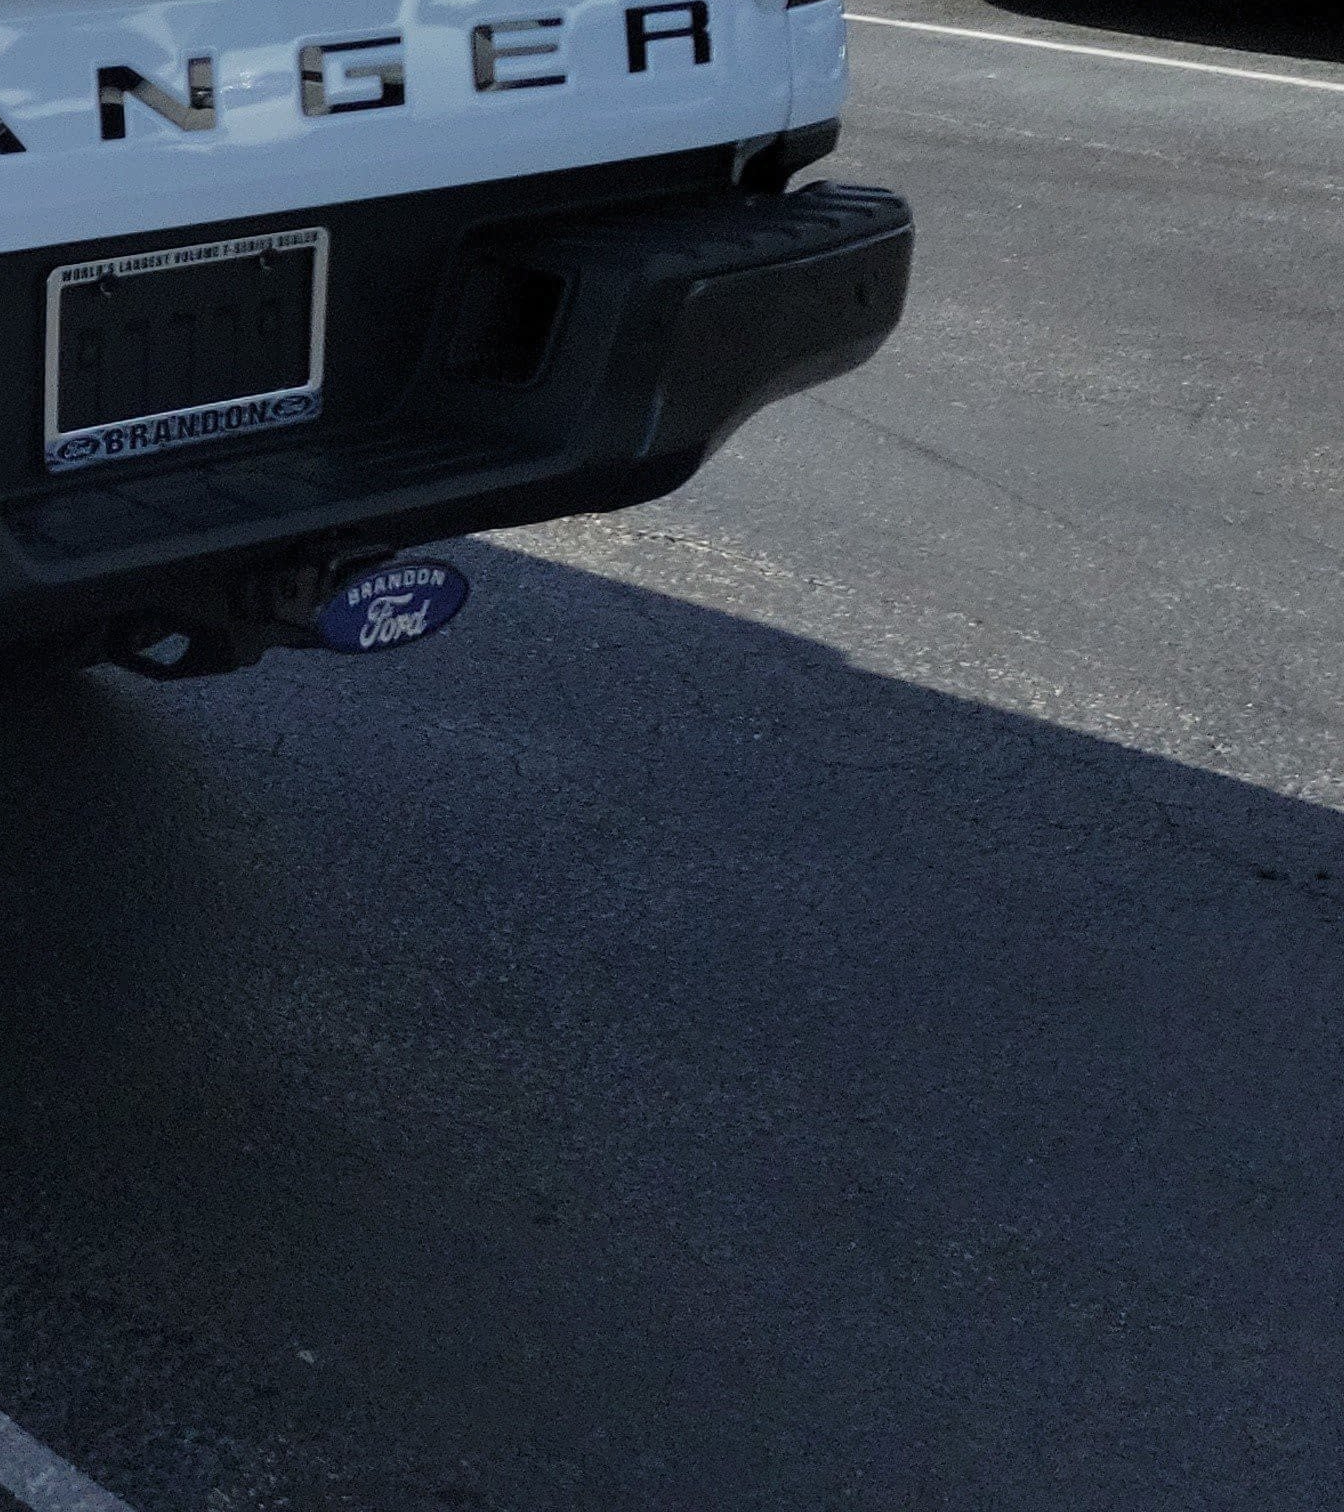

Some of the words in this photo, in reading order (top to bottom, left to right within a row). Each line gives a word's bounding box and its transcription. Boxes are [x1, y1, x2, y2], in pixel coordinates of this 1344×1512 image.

[102, 400, 269, 455] BRANDON
[347, 568, 446, 606] BRANDON
[359, 592, 431, 648] Ford
